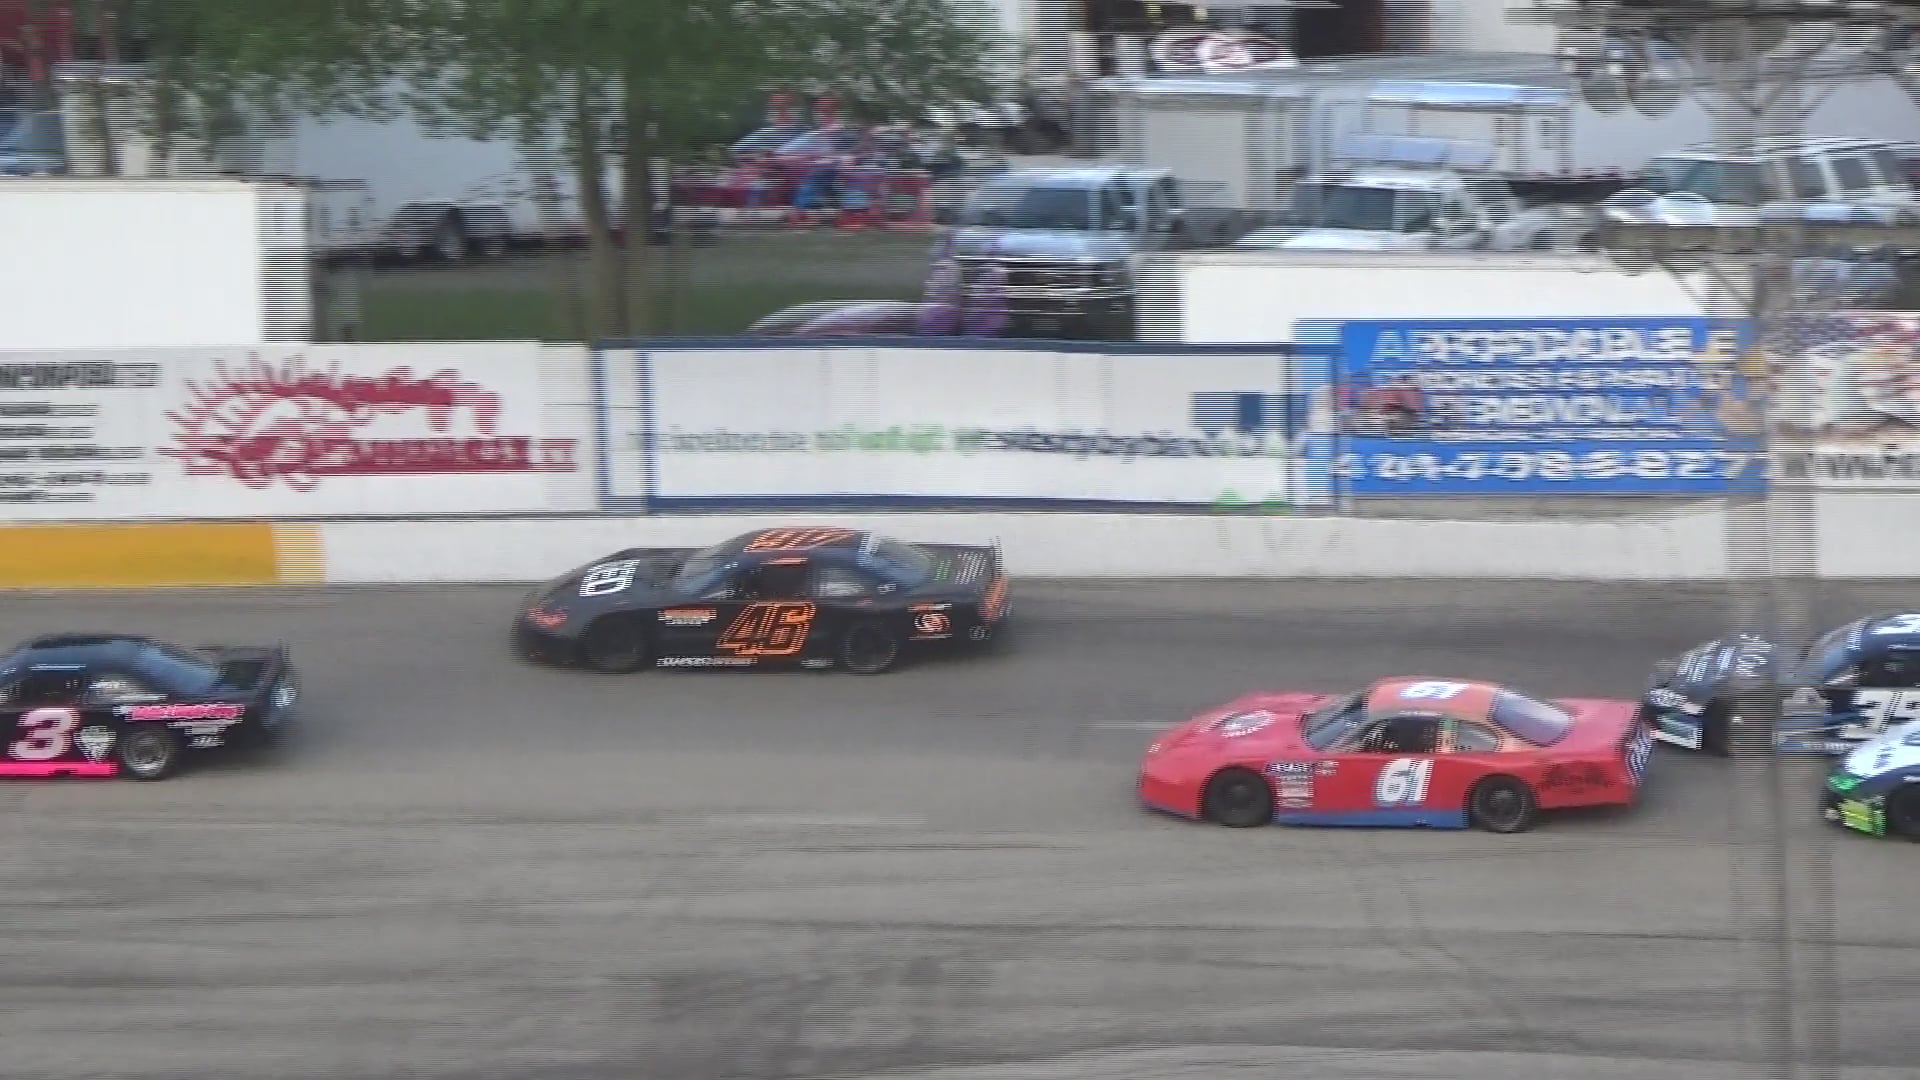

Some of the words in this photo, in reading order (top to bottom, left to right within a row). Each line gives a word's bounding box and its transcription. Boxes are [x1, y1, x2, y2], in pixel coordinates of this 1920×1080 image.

[1369, 327, 1738, 365] AFFORDABLE
[1431, 395, 1681, 426] REMOVAL
[716, 601, 816, 655] 46
[1399, 681, 1468, 702] 61
[8, 706, 82, 761] 3
[1376, 757, 1434, 804] 61
